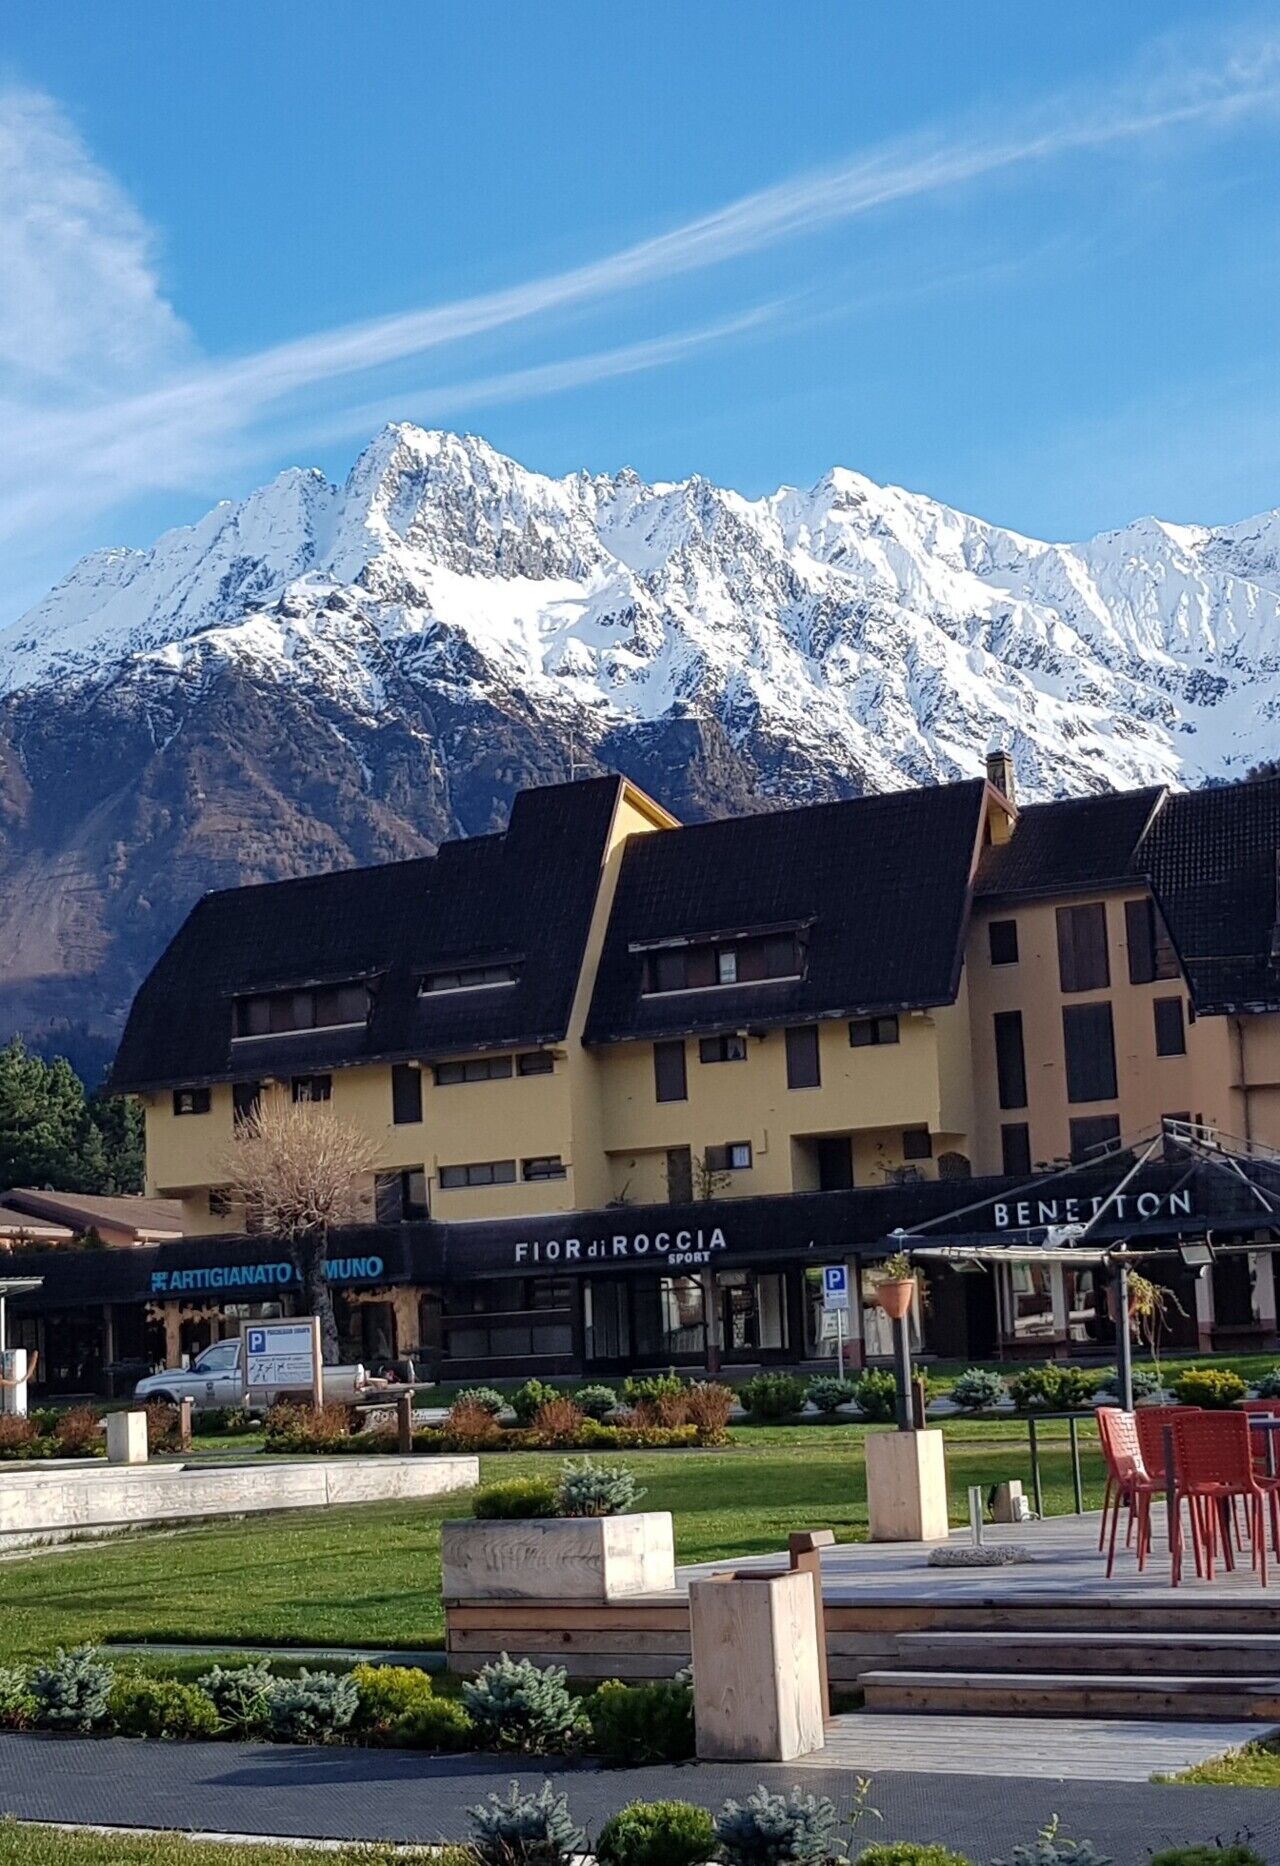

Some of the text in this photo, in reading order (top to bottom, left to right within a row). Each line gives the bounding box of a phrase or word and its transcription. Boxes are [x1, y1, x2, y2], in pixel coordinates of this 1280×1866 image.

[994, 1190, 1191, 1227] BENETTON
[515, 1228, 727, 1262] FIOR di ROCCIA
[668, 1251, 711, 1264] SPORT
[169, 1262, 292, 1290] ARTIGIANATO
[828, 1270, 841, 1288] P
[251, 1333, 263, 1351] P
